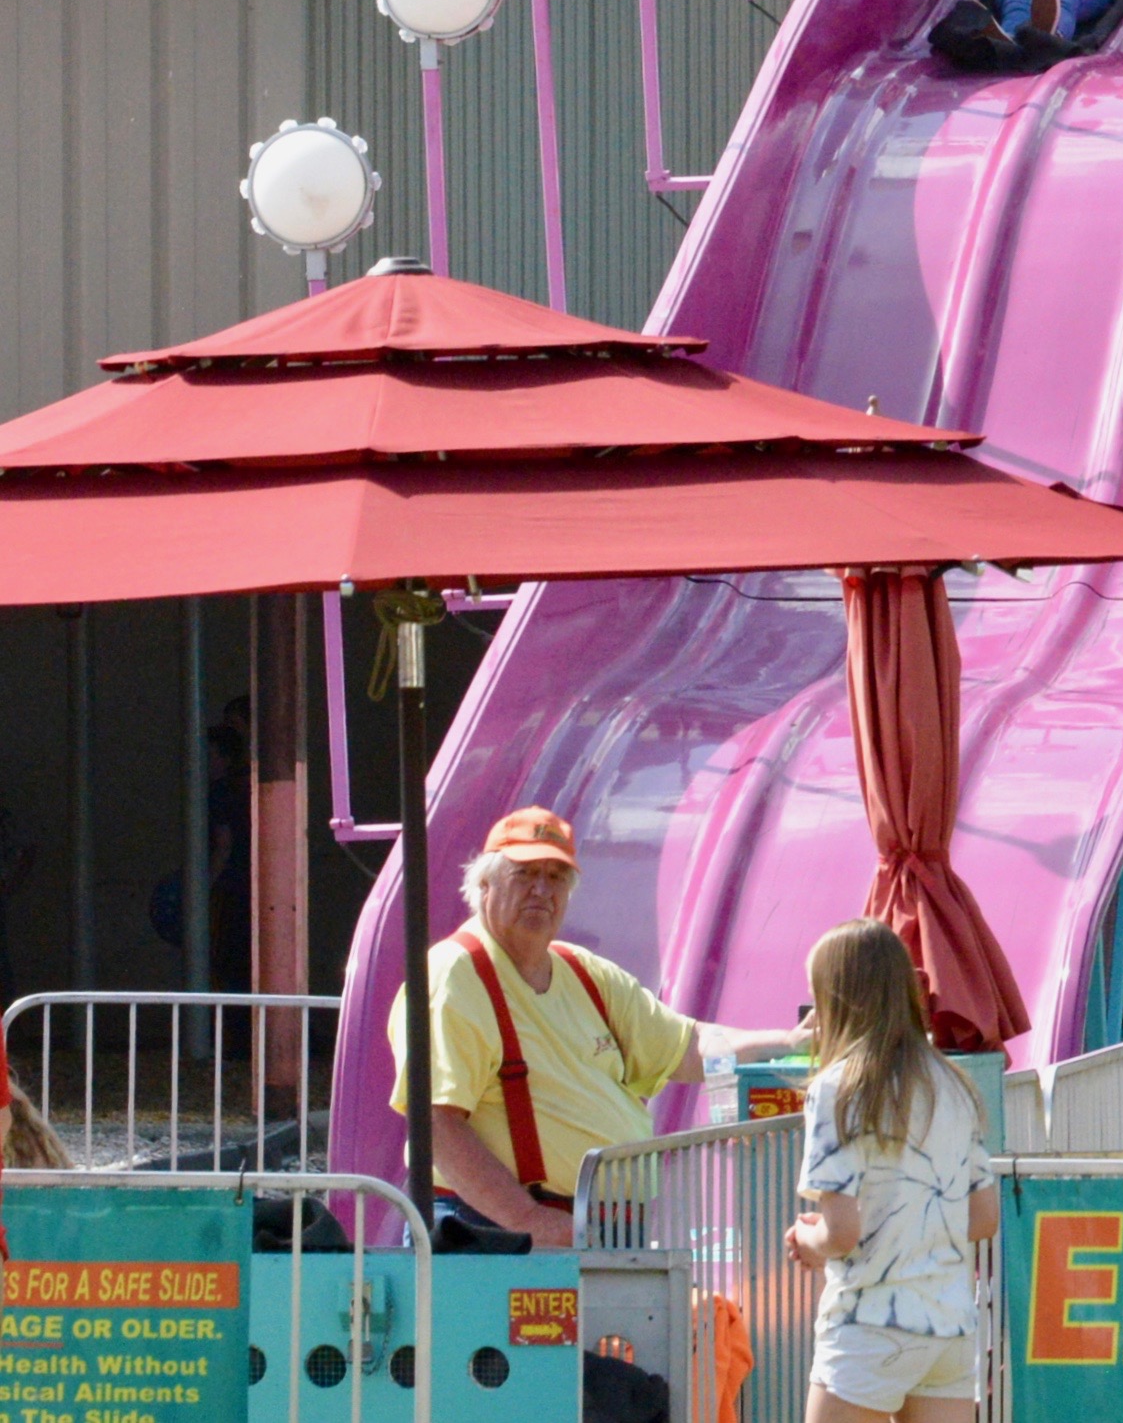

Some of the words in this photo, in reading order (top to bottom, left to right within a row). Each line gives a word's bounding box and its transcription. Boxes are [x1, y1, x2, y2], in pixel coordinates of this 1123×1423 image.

[3, 1270, 20, 1301] S
[27, 1267, 69, 1301] FOR
[74, 1268, 90, 1301] A
[98, 1268, 153, 1302] SAFE
[158, 1268, 223, 1302] SLIDE.
[510, 1292, 577, 1317] ENTER
[1, 1314, 64, 1338] AGE
[73, 1318, 113, 1339] OR
[121, 1318, 224, 1340] OLDER.
[0, 1354, 87, 1375] Health
[98, 1355, 208, 1376] Without
[75, 1382, 200, 1403] Ailments
[21, 1408, 74, 1423] The
